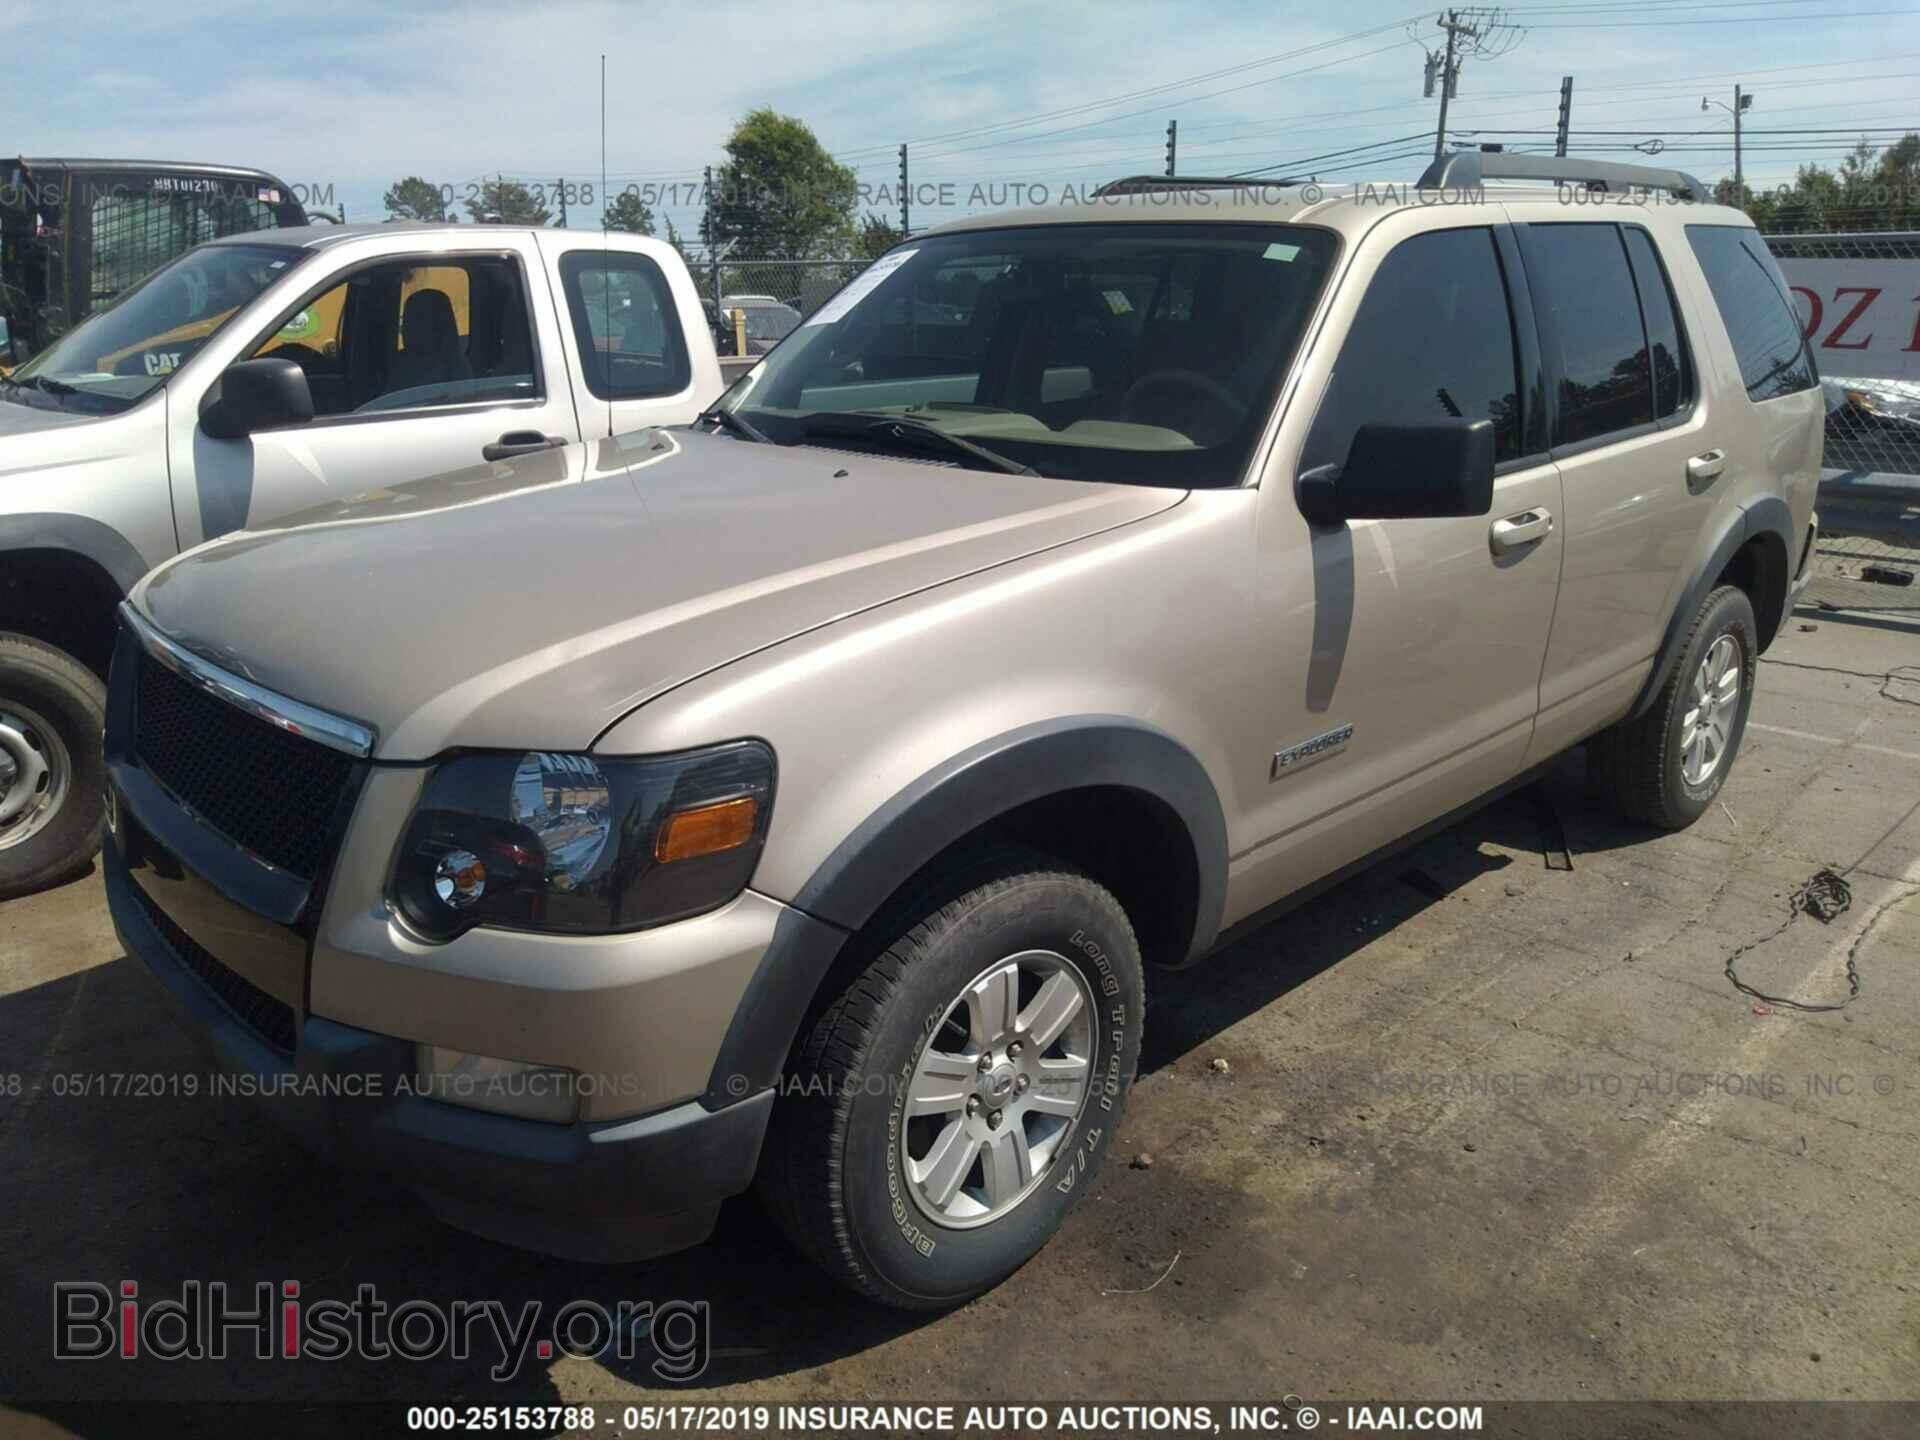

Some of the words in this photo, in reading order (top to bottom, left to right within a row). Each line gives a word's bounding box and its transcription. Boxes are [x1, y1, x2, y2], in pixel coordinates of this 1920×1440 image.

[144, 352, 181, 376] CAT
[1069, 929, 1120, 997] Long
[1056, 1127, 1102, 1193] T/A
